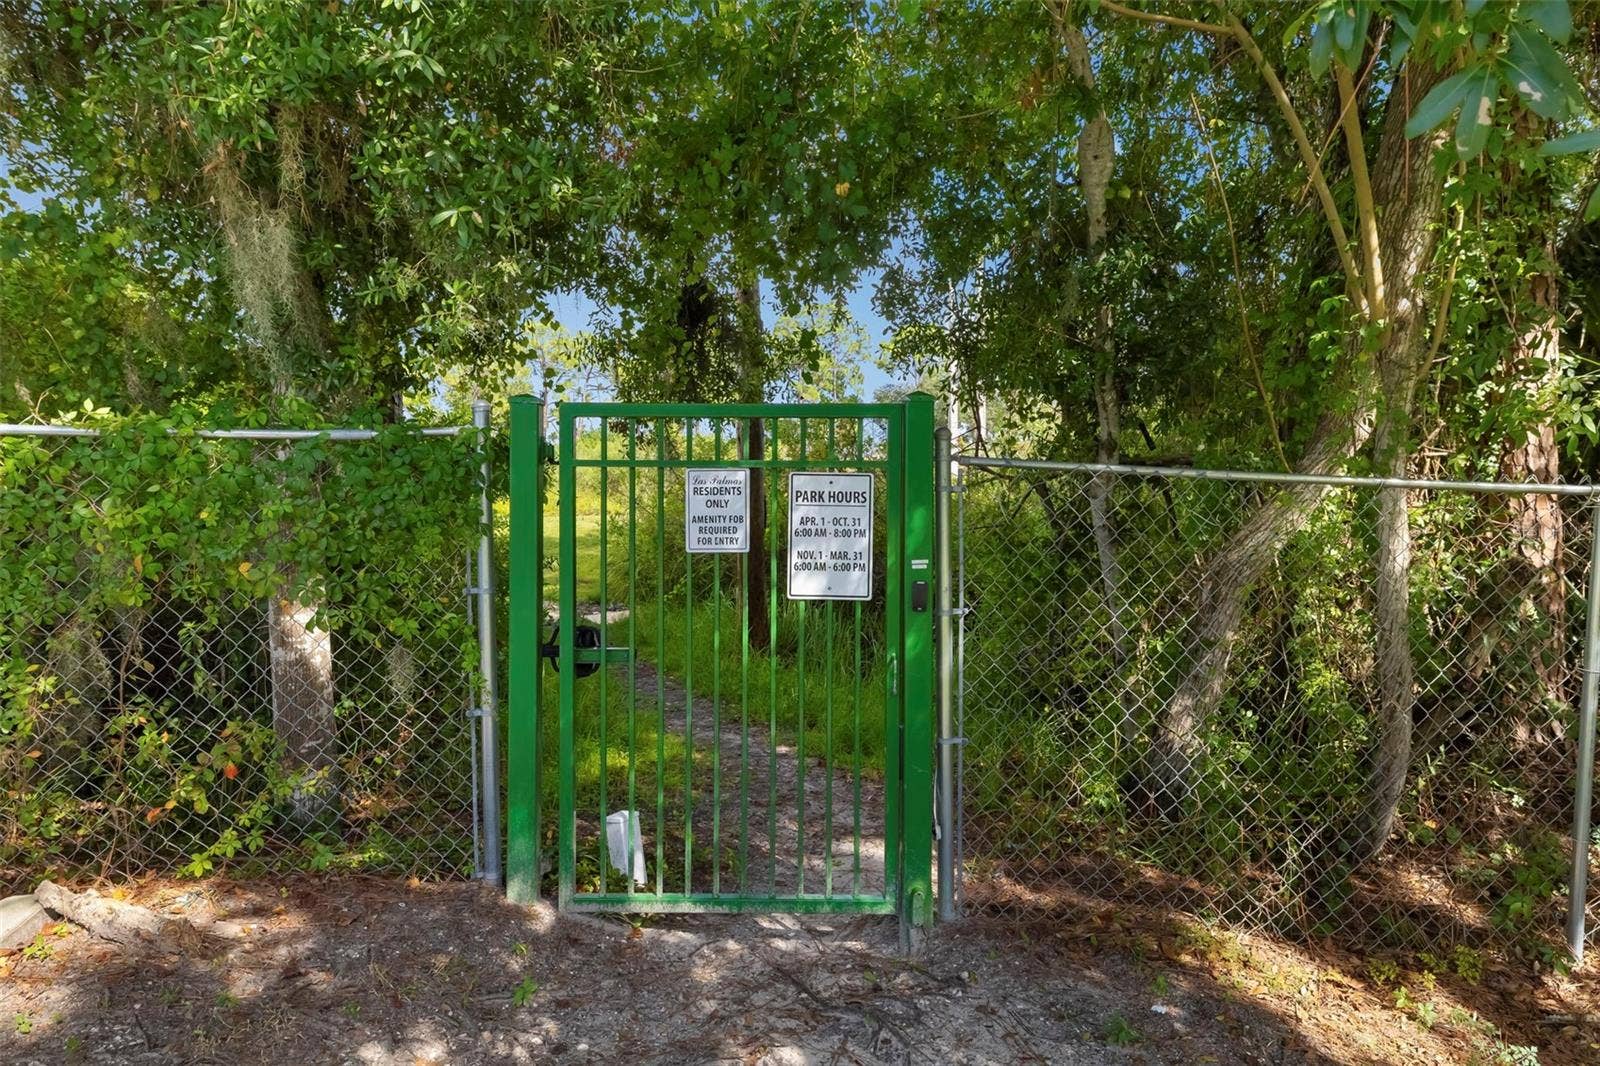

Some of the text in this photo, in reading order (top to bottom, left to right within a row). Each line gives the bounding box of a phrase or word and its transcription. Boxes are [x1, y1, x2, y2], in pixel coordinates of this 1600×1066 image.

[693, 487, 742, 495] RESIDENTS
[795, 491, 867, 504] PARK HOURS
[706, 500, 729, 508] ONLY
[692, 515, 744, 523] AMENITY FOB
[799, 517, 819, 526] APR.
[821, 517, 825, 526] 1
[832, 517, 850, 527] OCT.
[852, 517, 861, 527] 31
[699, 526, 737, 535] REQUIRED
[794, 528, 813, 538] 6:00
[814, 528, 827, 538] AM
[834, 529, 852, 538] 8:00
[854, 529, 867, 538] PM
[697, 537, 739, 545] FOR ENTRY
[797, 550, 817, 560] NOV.
[819, 551, 823, 560] 1
[830, 551, 851, 560] MAR.
[853, 552, 863, 561] 31
[794, 562, 812, 571] 6:00
[814, 562, 827, 571] AM
[833, 563, 851, 572] 6:00
[853, 563, 866, 572] PM
